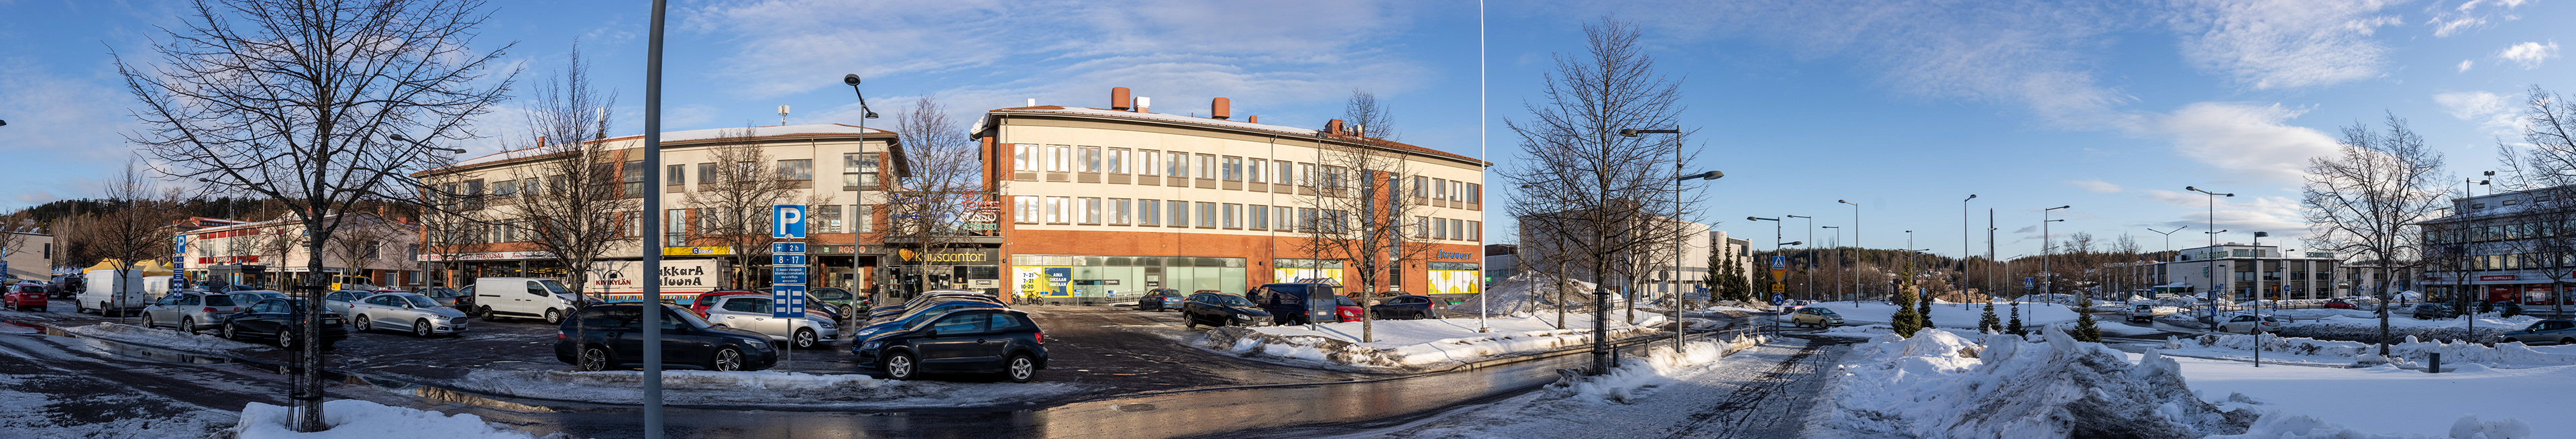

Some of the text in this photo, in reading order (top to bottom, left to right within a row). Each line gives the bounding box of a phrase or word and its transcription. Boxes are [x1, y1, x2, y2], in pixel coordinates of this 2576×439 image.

[780, 207, 800, 235] P
[178, 236, 184, 252] P
[839, 246, 866, 254] ROSO
[779, 256, 784, 264] 8
[792, 256, 799, 264] 17
